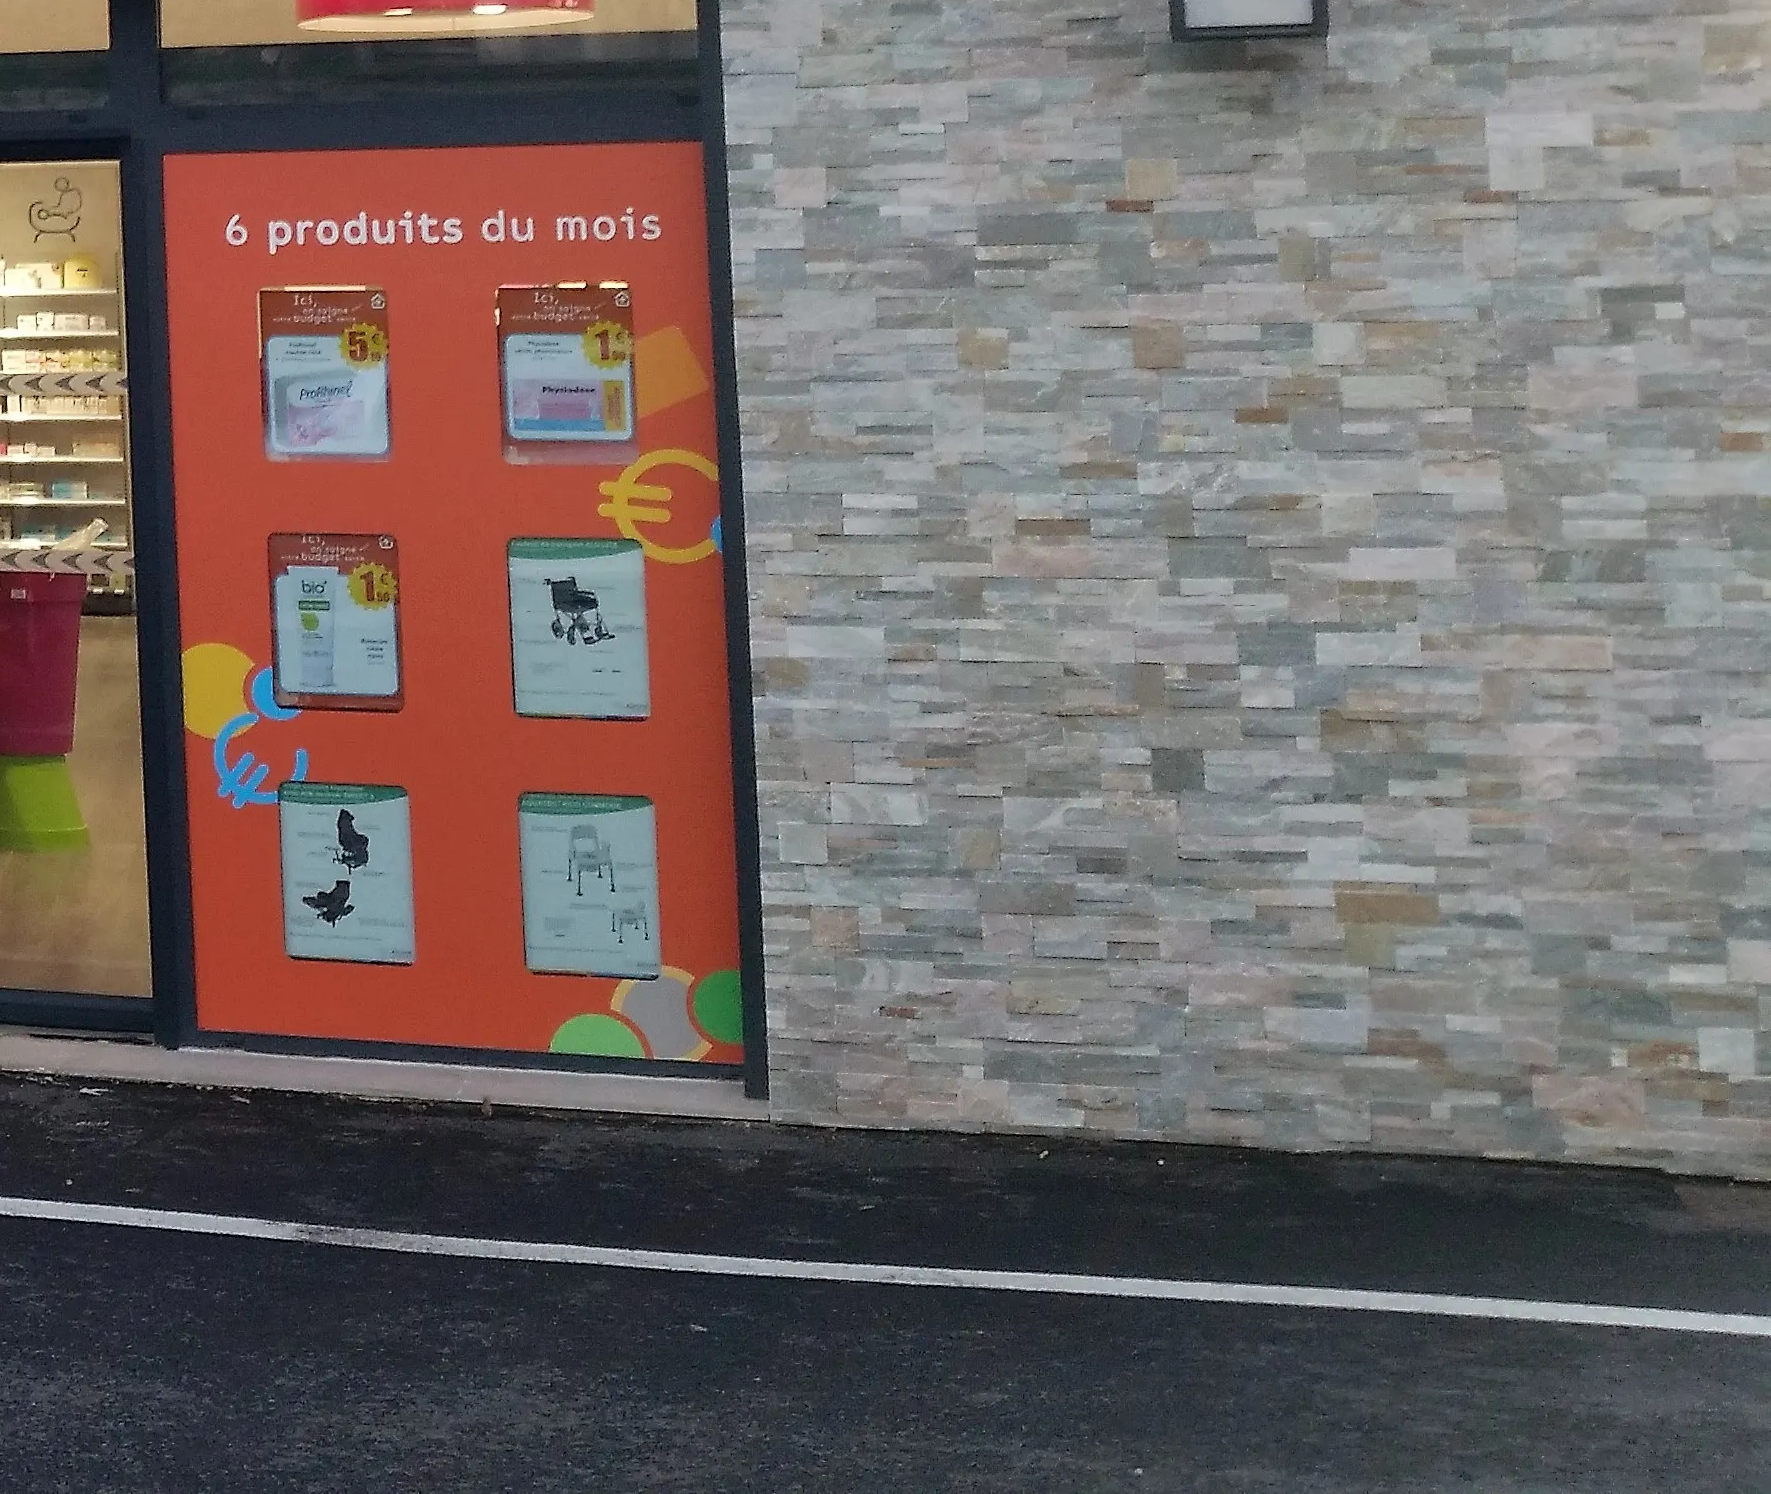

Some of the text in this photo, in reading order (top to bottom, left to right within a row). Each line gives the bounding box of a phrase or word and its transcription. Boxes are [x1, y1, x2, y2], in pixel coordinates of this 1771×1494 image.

[225, 207, 662, 254] 6 produits du mois
[349, 331, 368, 362] 5
[595, 329, 609, 360] 1
[360, 571, 374, 602] 1
